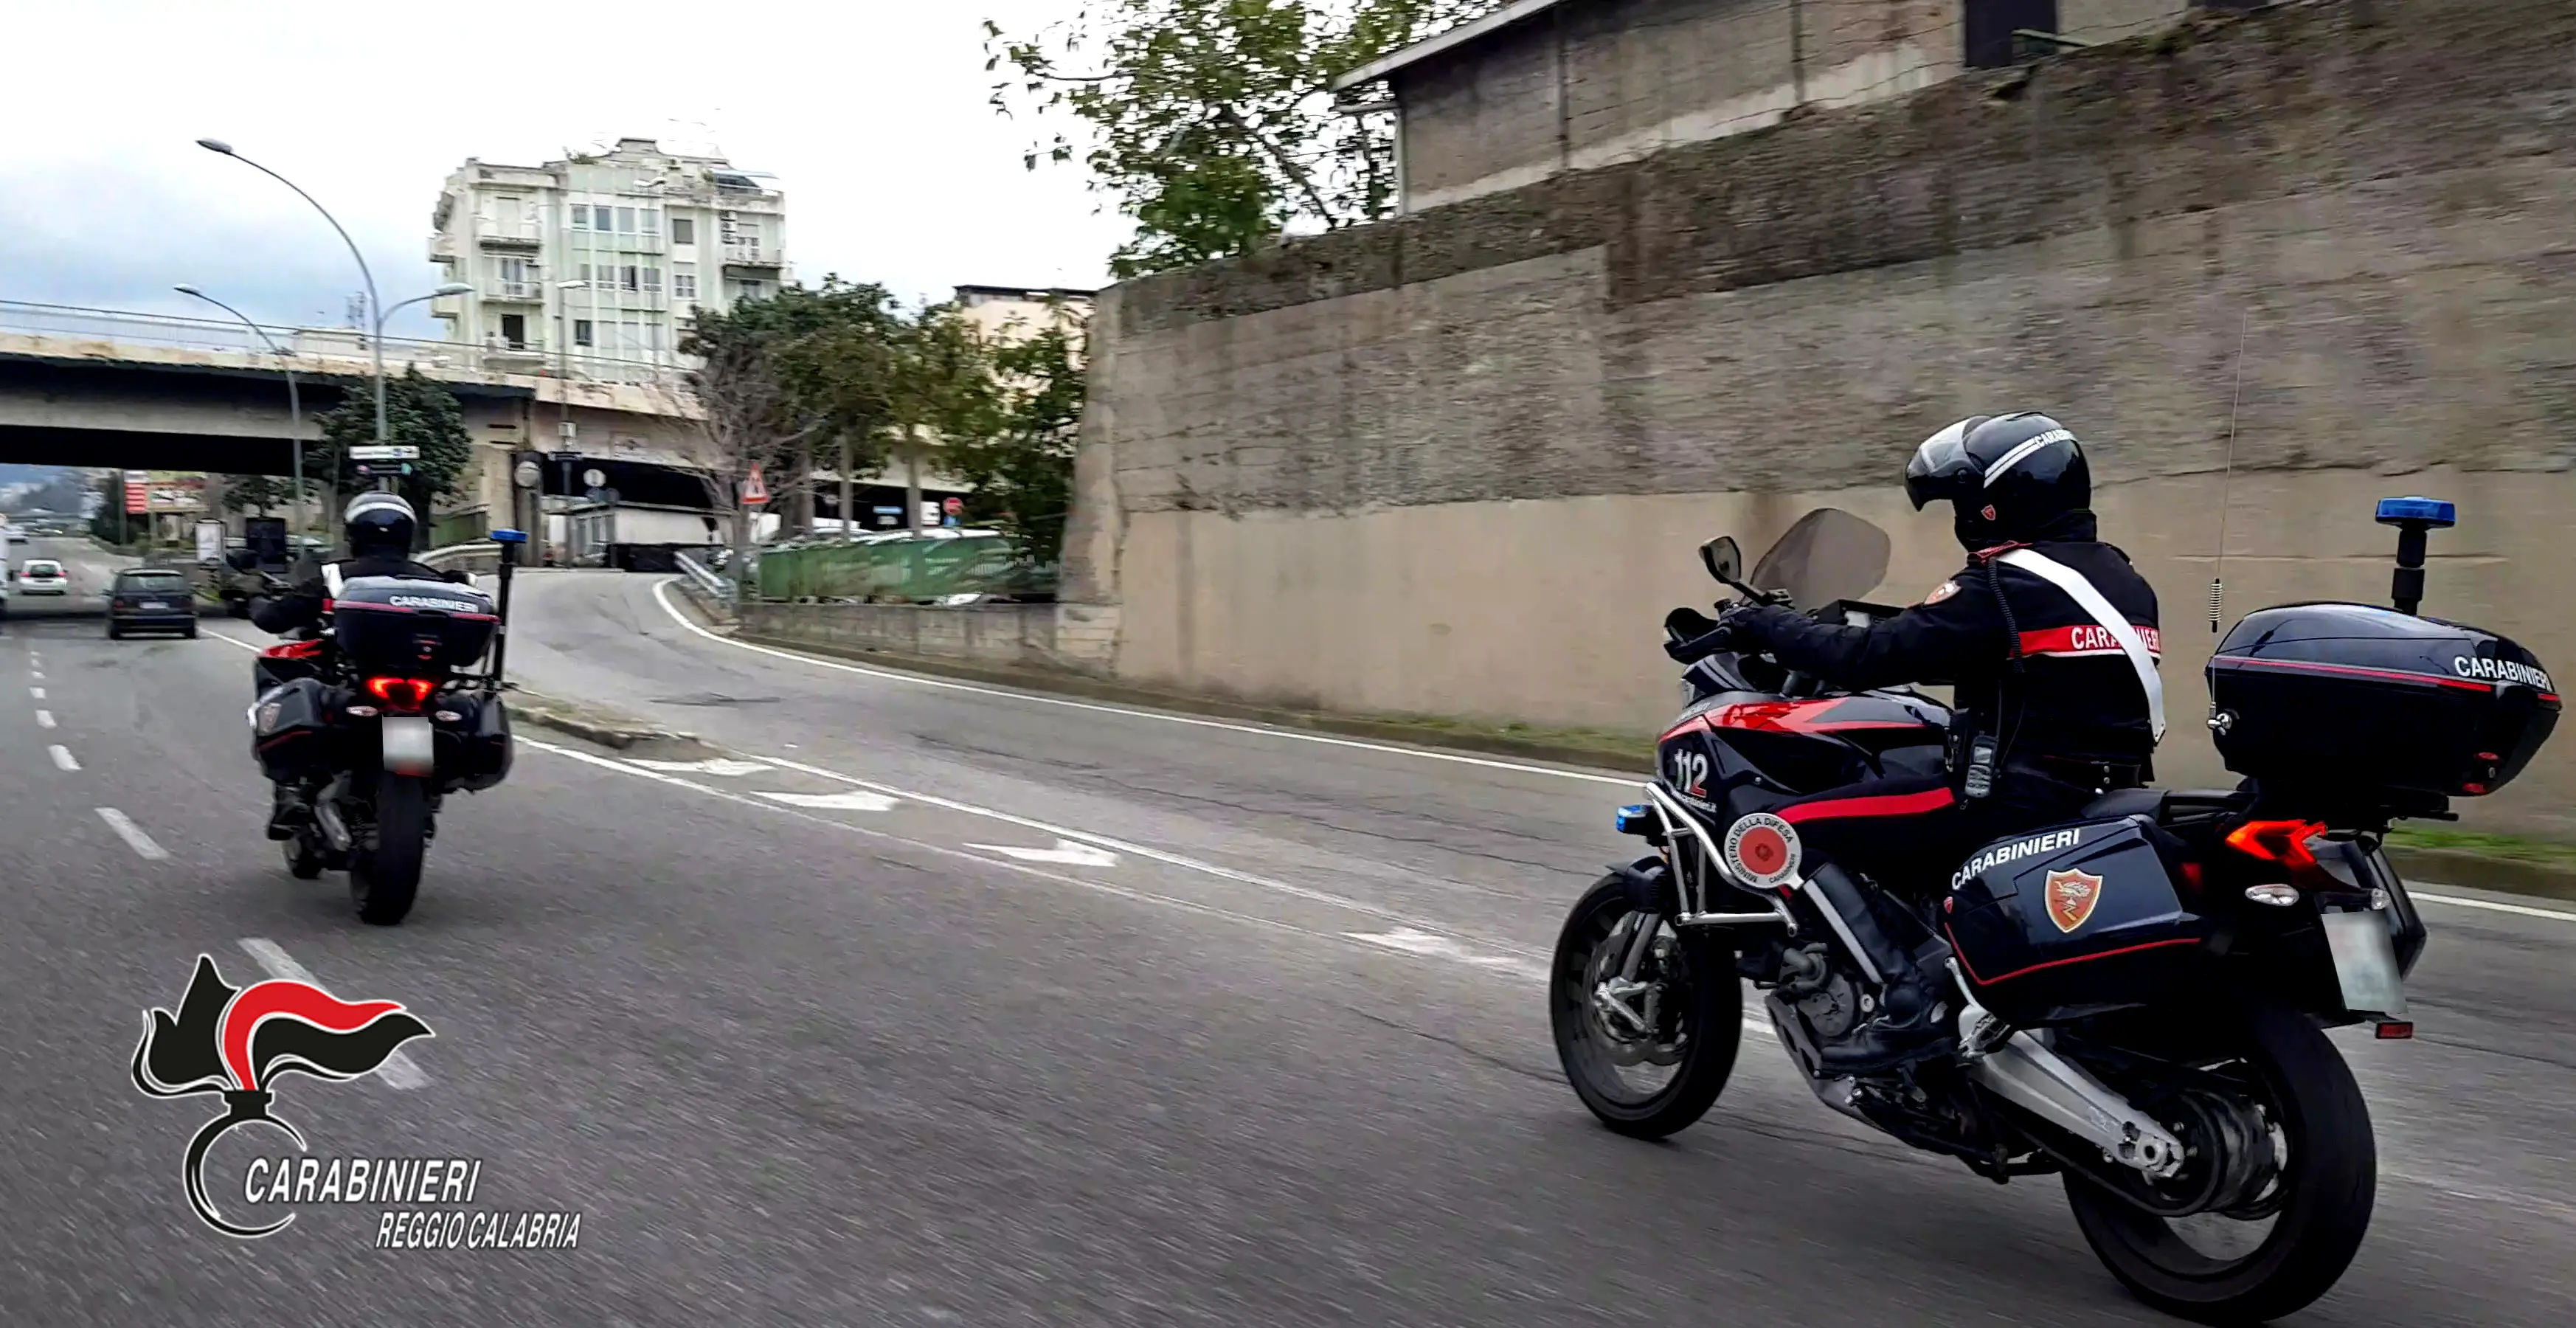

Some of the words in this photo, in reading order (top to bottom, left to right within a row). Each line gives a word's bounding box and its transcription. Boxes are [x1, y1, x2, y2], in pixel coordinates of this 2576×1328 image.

[1674, 748, 1708, 798] 112
[1734, 817, 1762, 837] DELLA
[1764, 817, 1793, 843] DIFESA
[1728, 837, 1758, 883] MINISTERO
[1951, 829, 2080, 890] CARABINIERI
